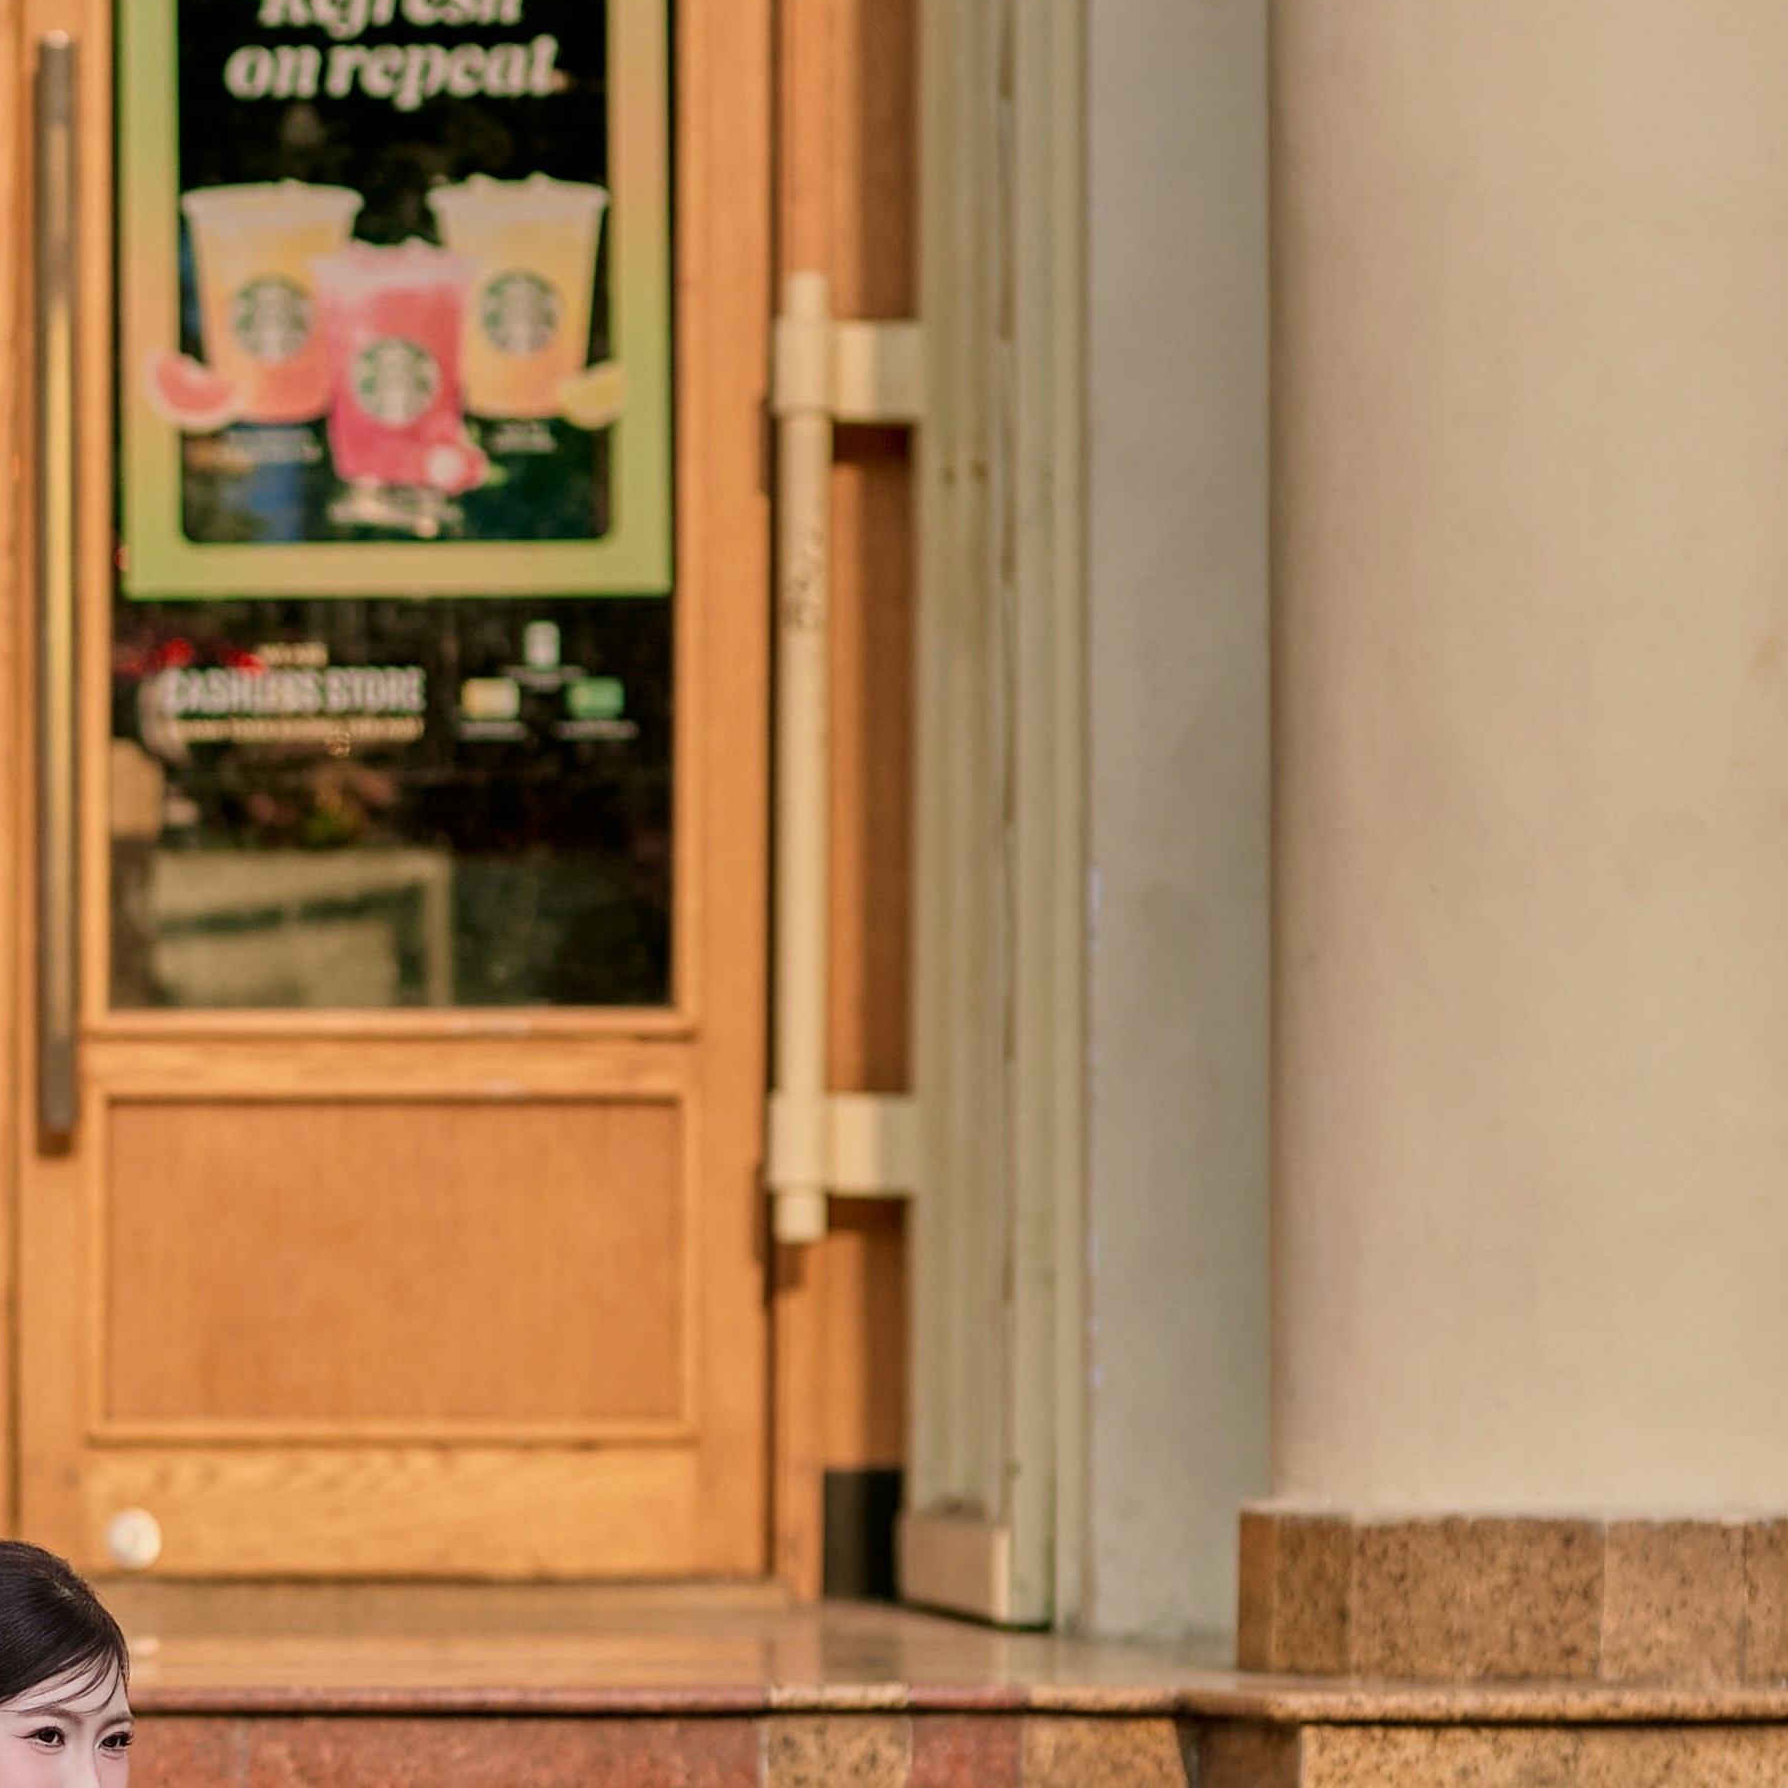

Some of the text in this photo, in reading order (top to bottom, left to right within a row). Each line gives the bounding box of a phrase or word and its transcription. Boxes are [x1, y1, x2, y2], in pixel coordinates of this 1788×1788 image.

[224, 33, 558, 110] on repeat
[324, 666, 427, 713] STORE
